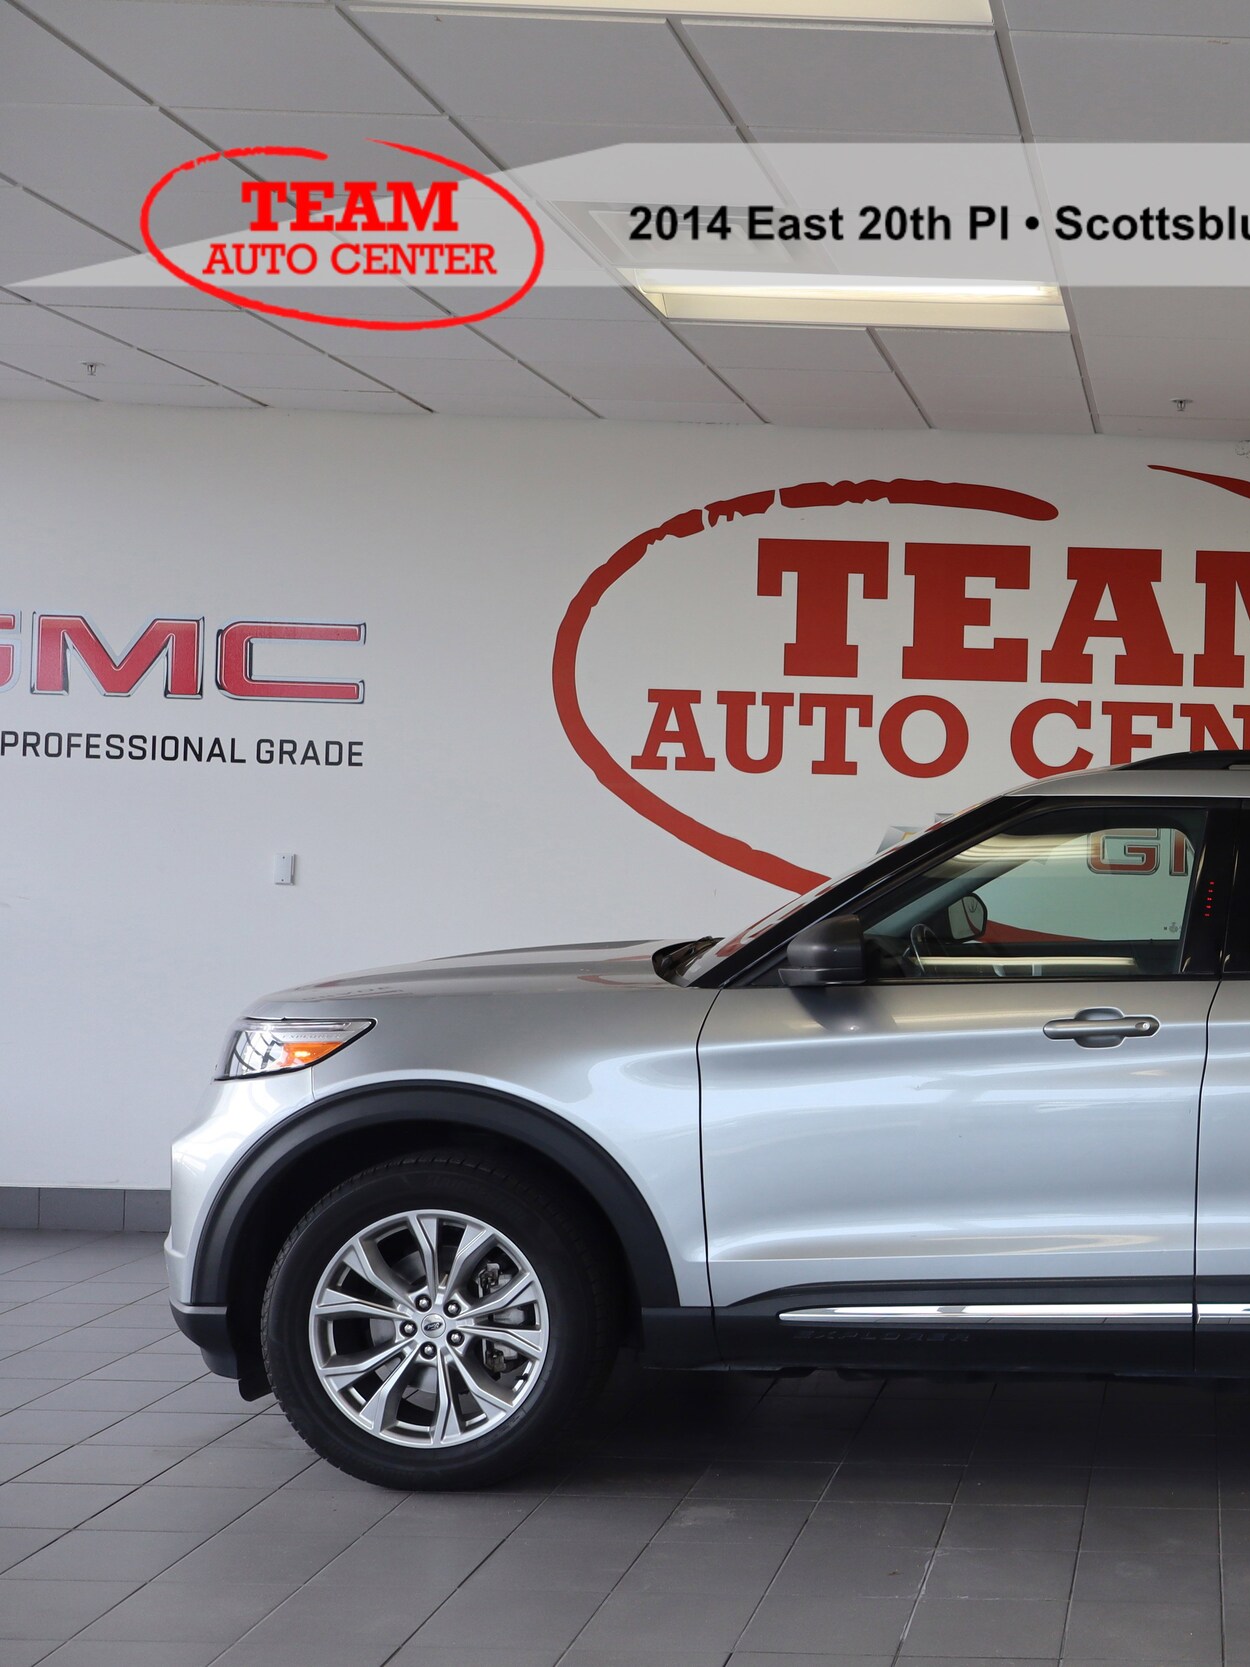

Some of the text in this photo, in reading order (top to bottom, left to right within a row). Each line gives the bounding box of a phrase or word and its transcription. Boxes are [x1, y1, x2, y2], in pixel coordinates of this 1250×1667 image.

[0, 608, 366, 704] MC
[0, 730, 364, 767] PROFESSIONAL GRADE
[630, 689, 970, 779] AUTO
